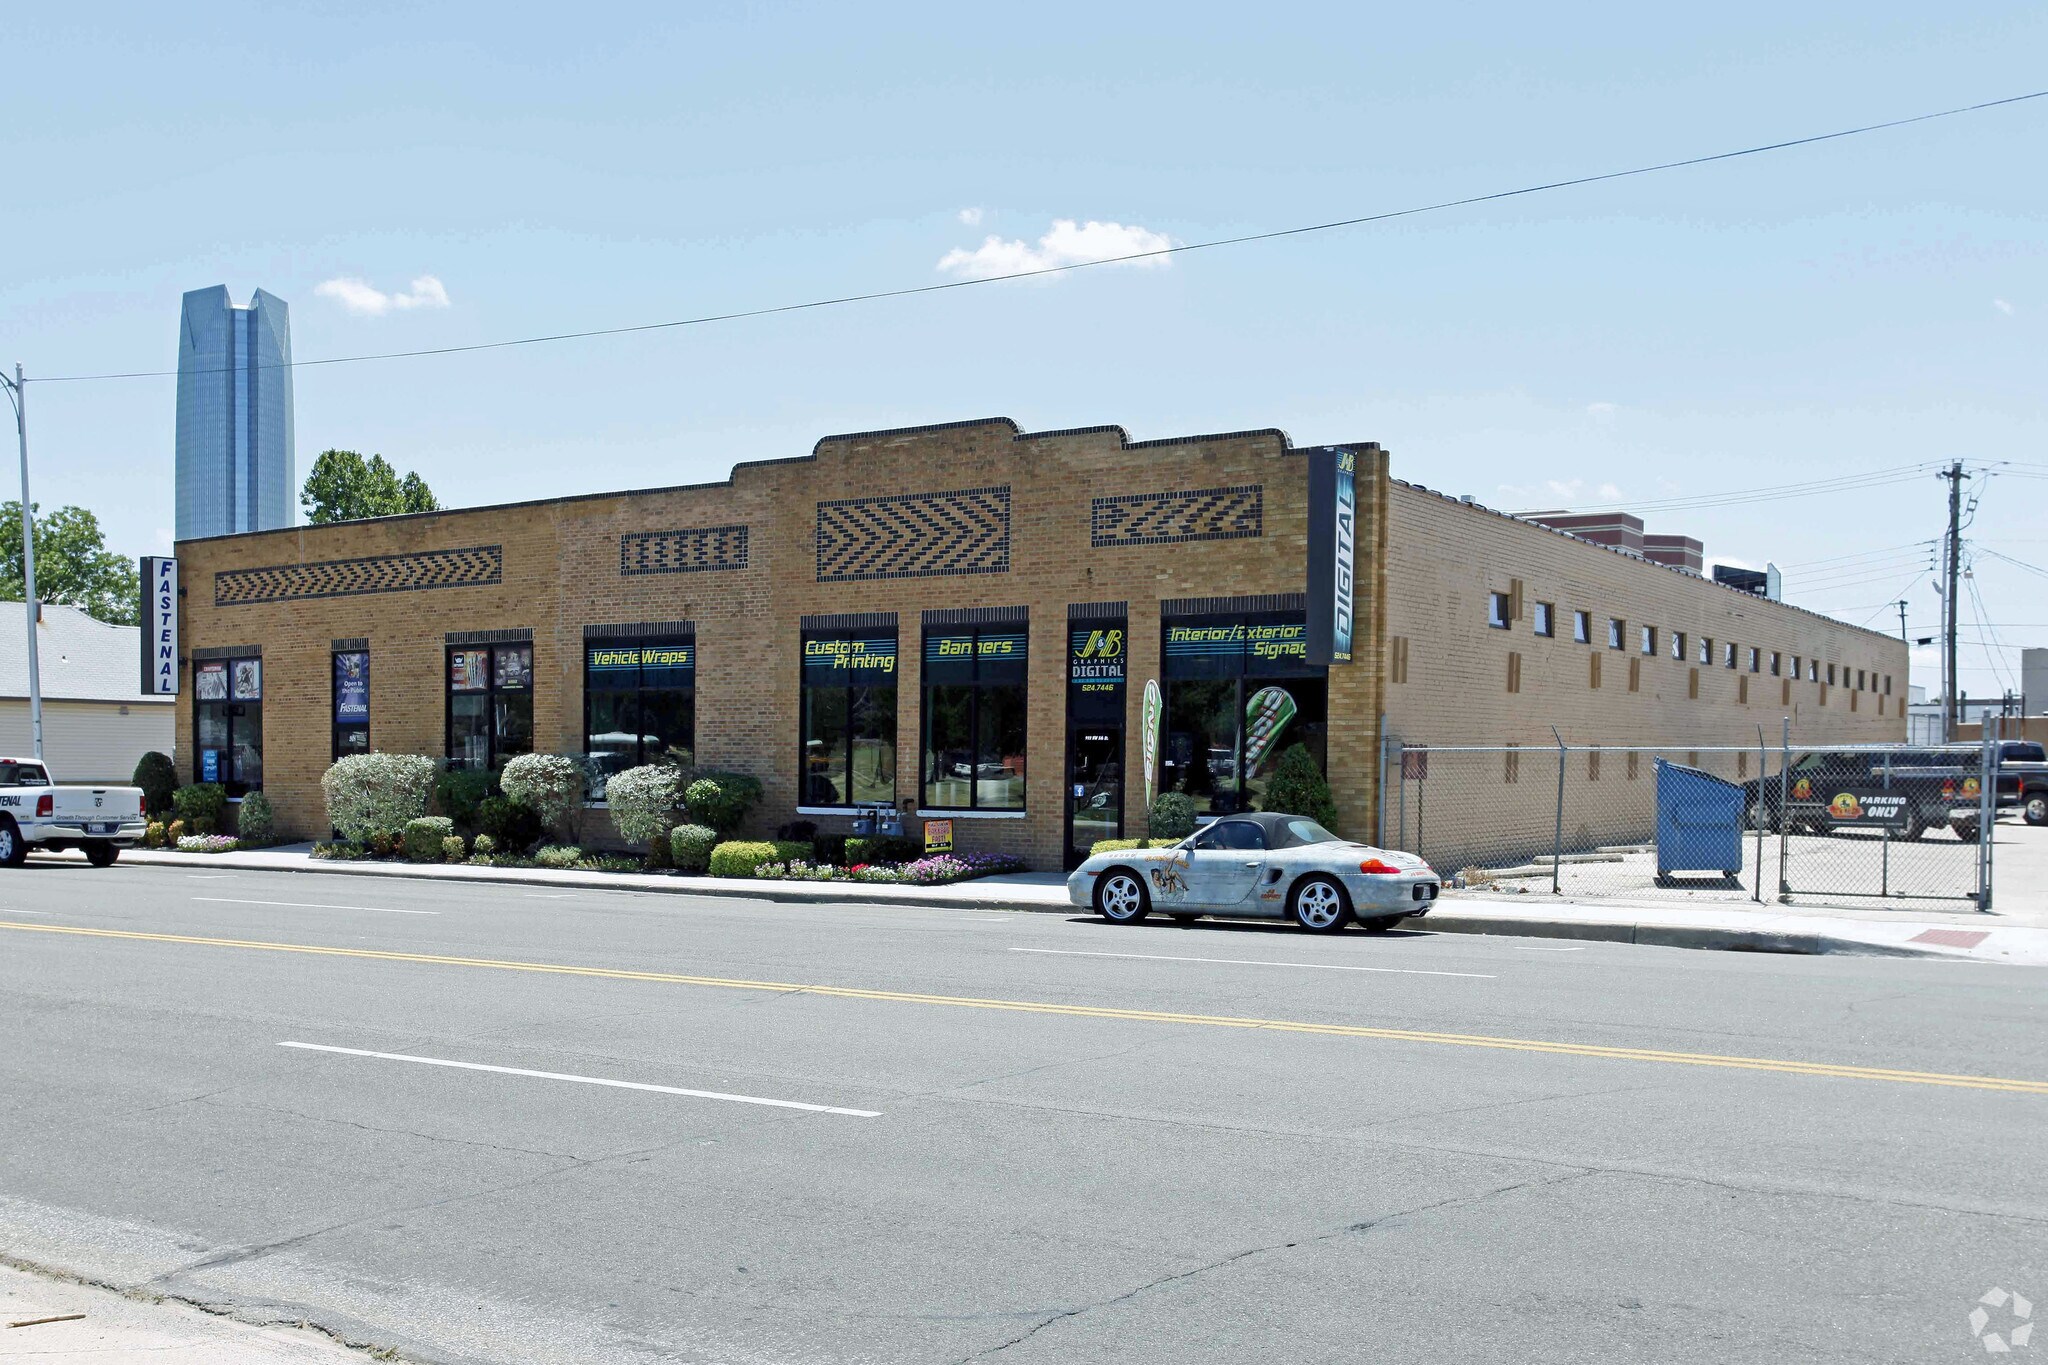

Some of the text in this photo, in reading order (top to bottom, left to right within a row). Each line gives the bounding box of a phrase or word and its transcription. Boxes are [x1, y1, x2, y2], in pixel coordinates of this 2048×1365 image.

[1337, 492, 1352, 639] DIGITAL
[160, 561, 173, 692] FASTENAL
[805, 640, 865, 655] Custom
[594, 649, 688, 666] Vehicle Wraps
[833, 653, 895, 672] Printing
[1072, 665, 1124, 677] DIGITAL
[344, 680, 358, 688] Open
[350, 686, 365, 694] Public
[1081, 684, 1114, 692] 524.7446
[340, 703, 368, 713] FASTENAL
[1860, 796, 1907, 805] PARKING
[1867, 805, 1899, 818] ONLY
